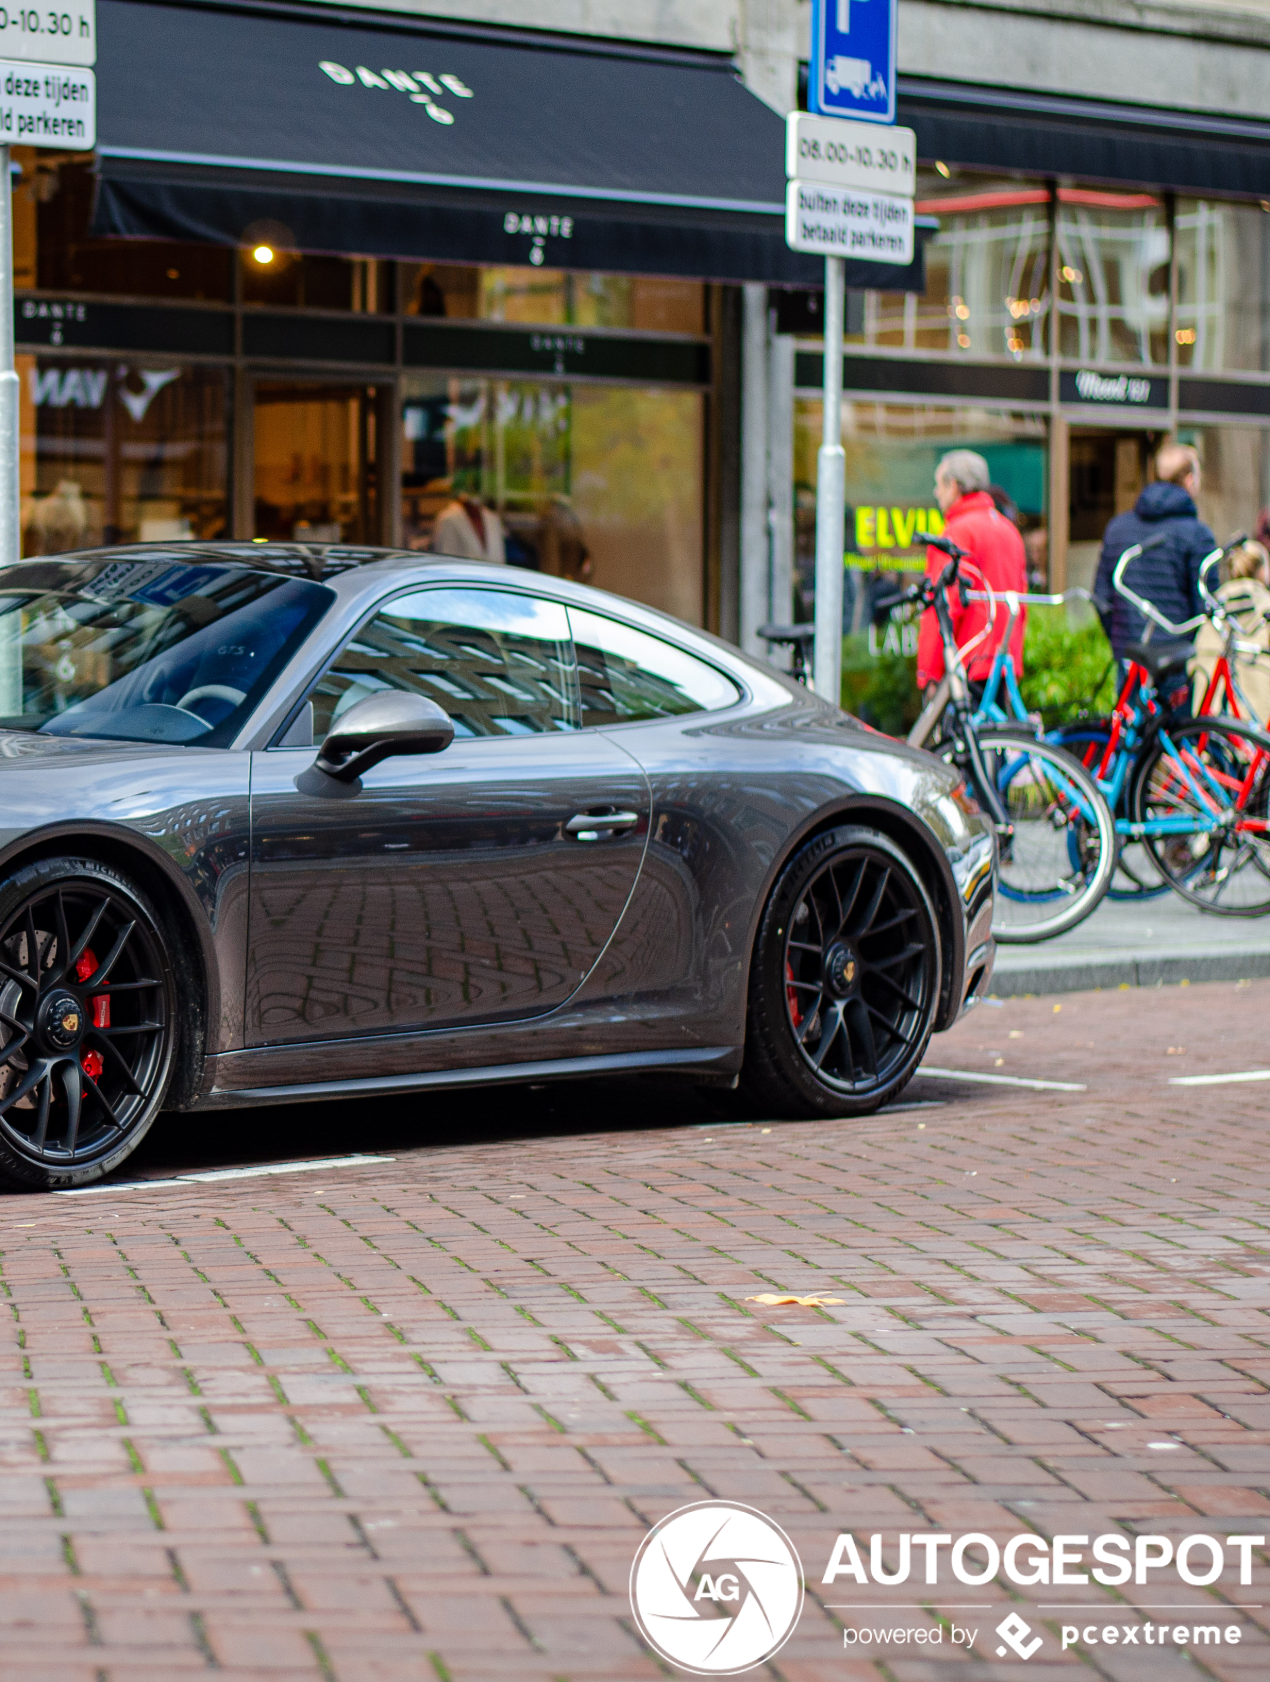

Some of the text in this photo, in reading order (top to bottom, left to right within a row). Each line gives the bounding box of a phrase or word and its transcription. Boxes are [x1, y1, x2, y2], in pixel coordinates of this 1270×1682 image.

[79, 15, 90, 38] h
[5, 71, 40, 97] deze
[44, 75, 88, 107] tijden
[318, 60, 474, 98] DANTE
[18, 110, 85, 138] parkeren
[799, 138, 912, 173] 08.00-10.30 h
[503, 212, 574, 239] DANTE
[799, 192, 908, 228] buiten deze tijden
[801, 220, 905, 255] betaald parkeren
[22, 301, 86, 322] DANTE
